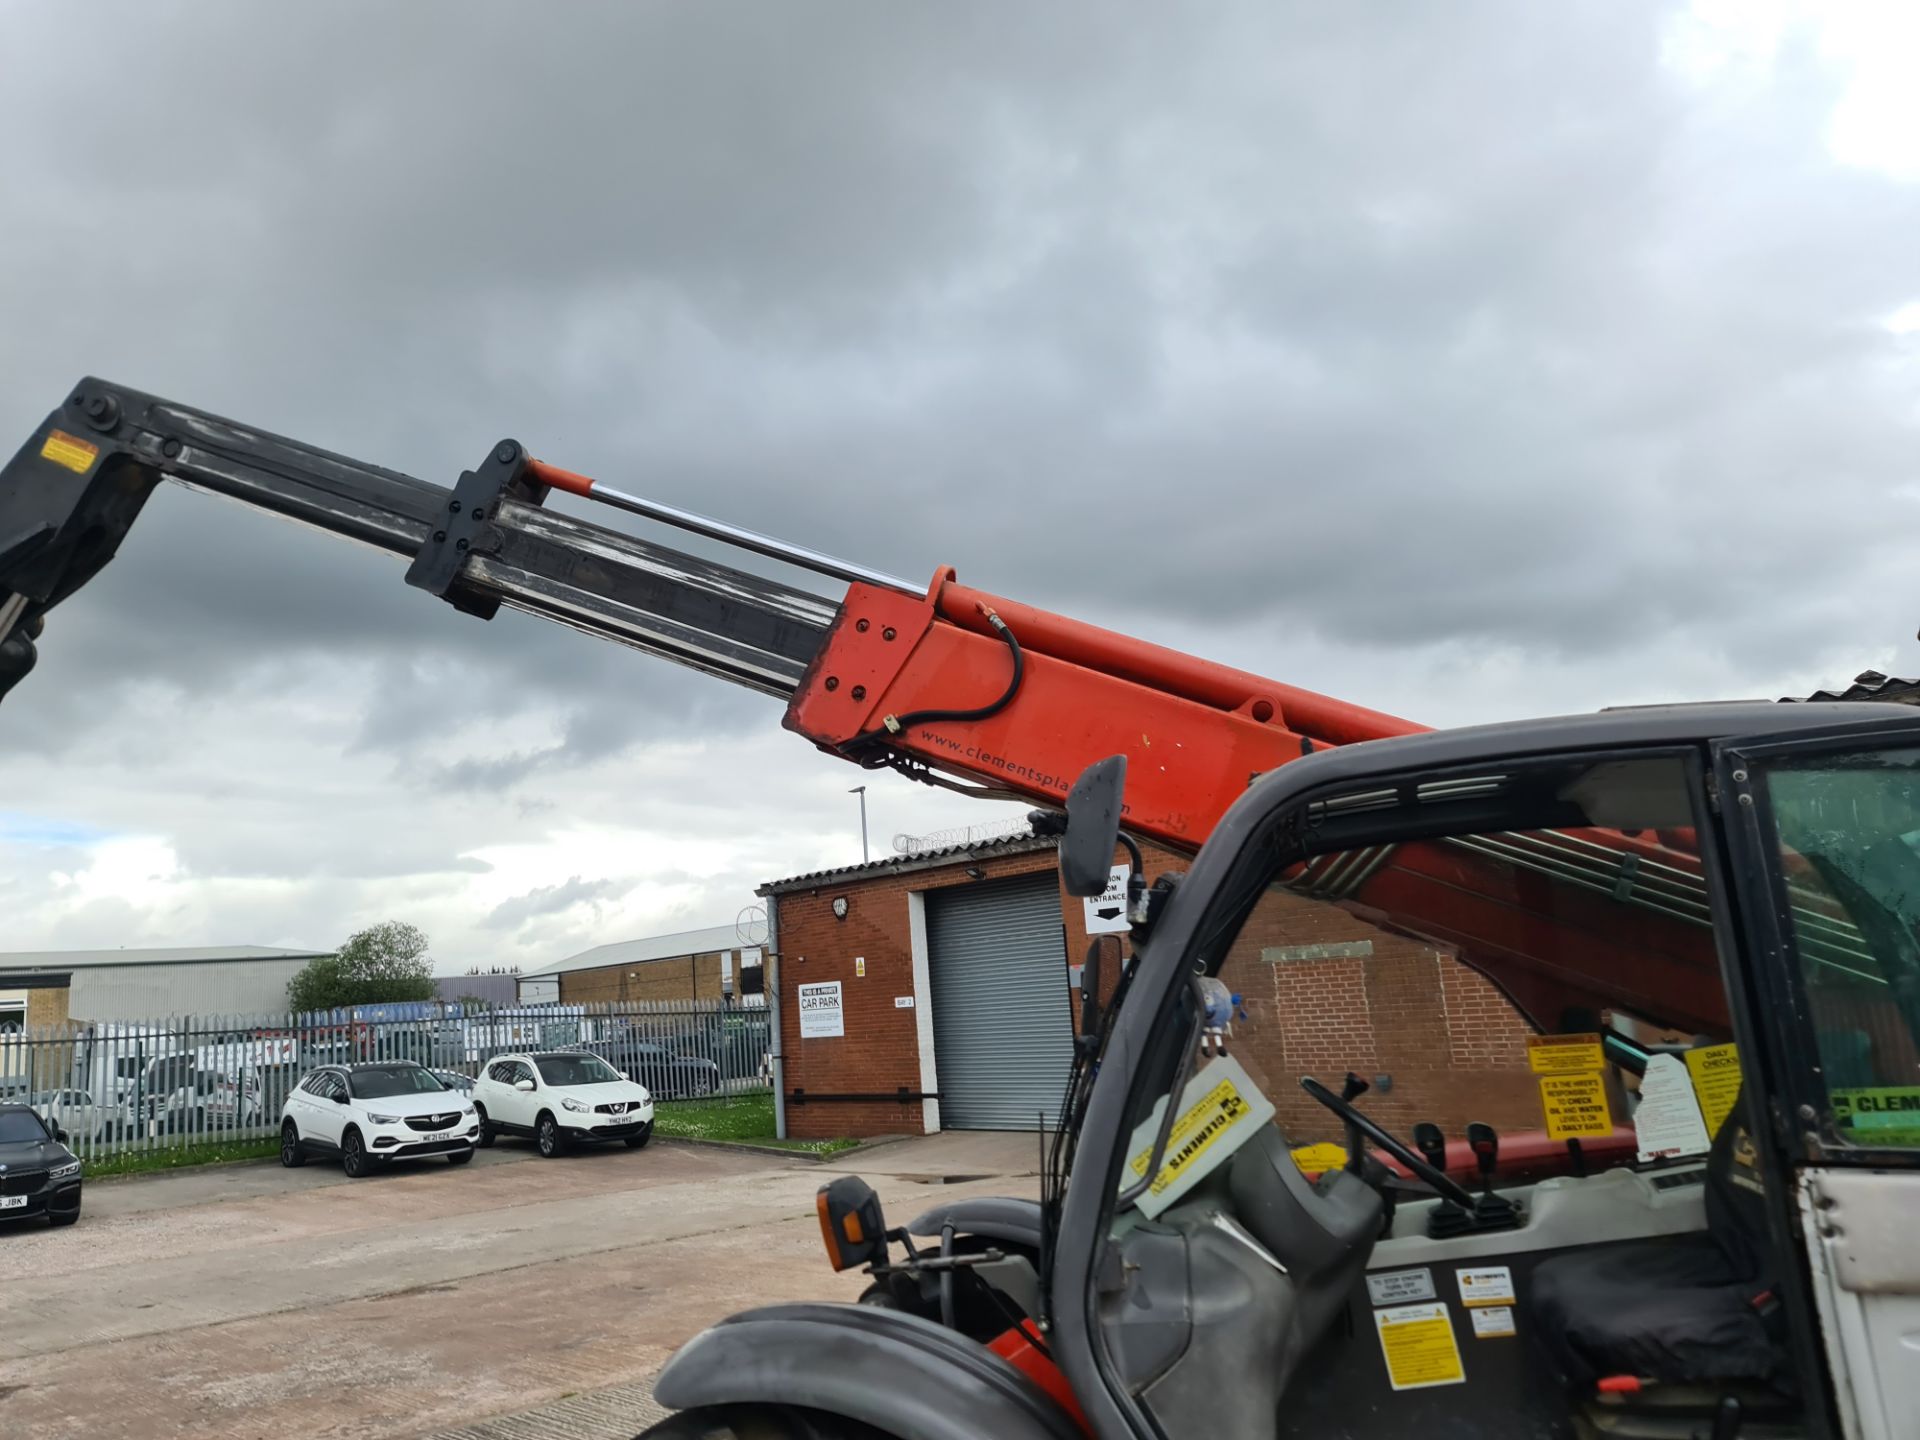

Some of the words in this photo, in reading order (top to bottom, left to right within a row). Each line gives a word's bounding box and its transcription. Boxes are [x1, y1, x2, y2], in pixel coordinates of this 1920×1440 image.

[1089, 893, 1127, 904] ENTRANCE
[801, 997, 818, 1009] CAR
[819, 996, 840, 1008] PARK
[1705, 1048, 1729, 1059] DAILY
[1702, 1056, 1738, 1069] CHECKS
[1559, 1080, 1571, 1088] THE
[1547, 1087, 1599, 1097] RESPONSIBILITY
[1567, 1097, 1592, 1105] CHECK
[1549, 1107, 1561, 1115] OIL
[1578, 1105, 1603, 1113] WATER
[1562, 1123, 1582, 1131] DAILY
[1585, 1122, 1604, 1130] BASIS
[1168, 1114, 1226, 1170] CLEMENTS
[6, 1197, 23, 1207] JBK
[1401, 1274, 1423, 1282] ENGINE
